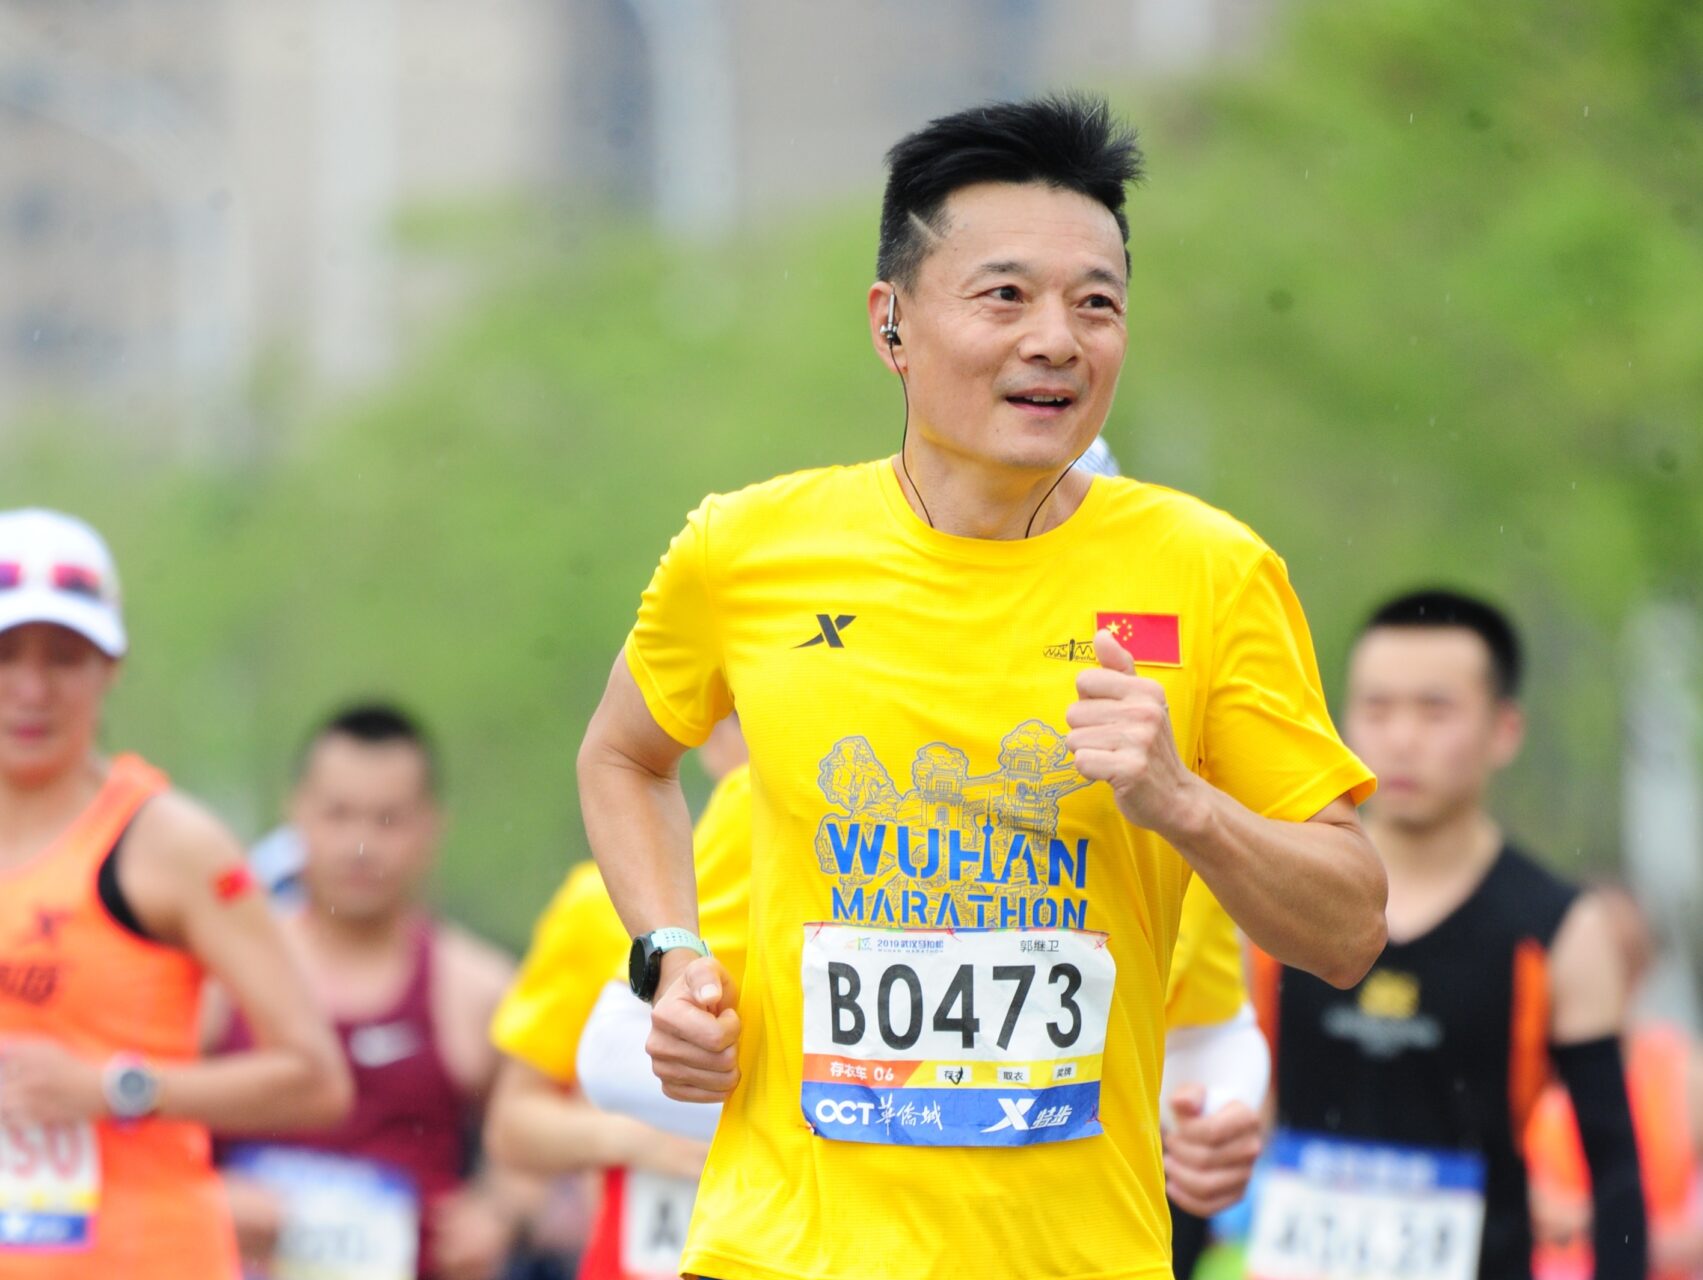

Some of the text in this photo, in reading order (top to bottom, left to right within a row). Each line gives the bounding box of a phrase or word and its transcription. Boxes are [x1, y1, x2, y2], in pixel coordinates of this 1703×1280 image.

[825, 822, 1090, 889] WUHAN
[831, 886, 1089, 930] MARATHON
[827, 960, 1083, 1051] B0473
[873, 1066, 895, 1082] 06
[1002, 1070, 1024, 1081] 取衣
[815, 1098, 875, 1126] OCT
